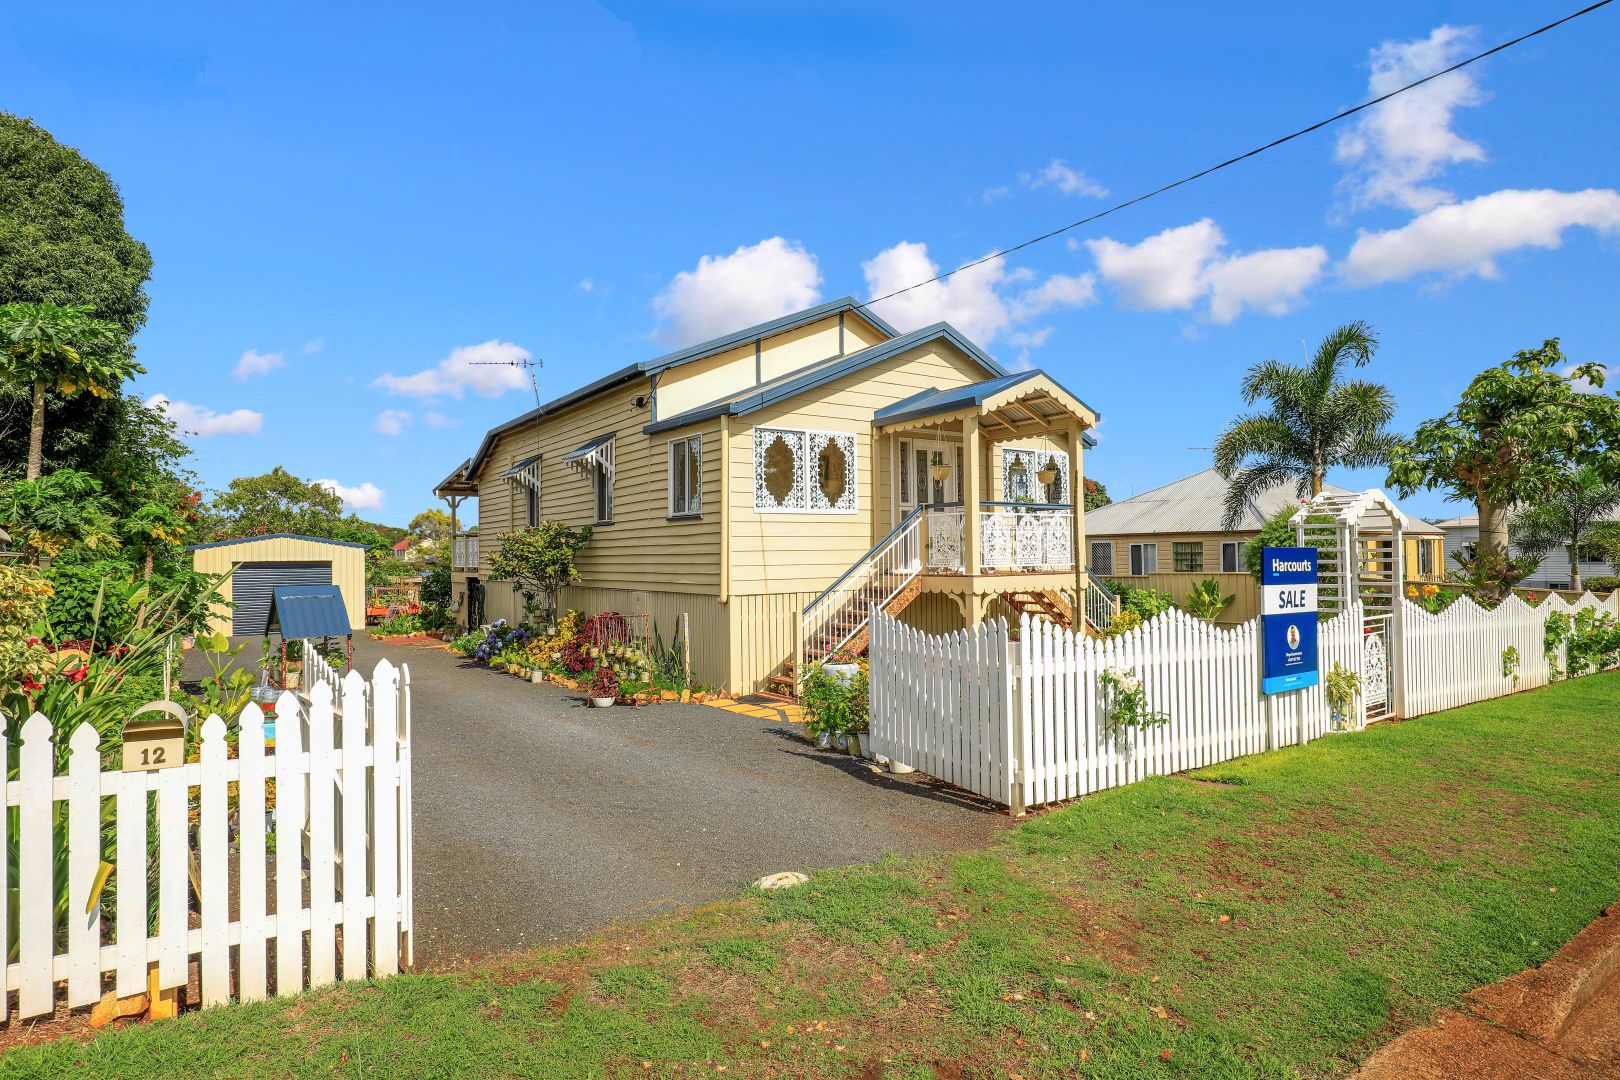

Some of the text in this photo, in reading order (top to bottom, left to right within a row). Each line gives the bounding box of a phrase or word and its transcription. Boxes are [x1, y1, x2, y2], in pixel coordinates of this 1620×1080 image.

[1272, 558, 1312, 572] Harcourts
[1278, 590, 1306, 609] SALE
[140, 746, 167, 766] 12
